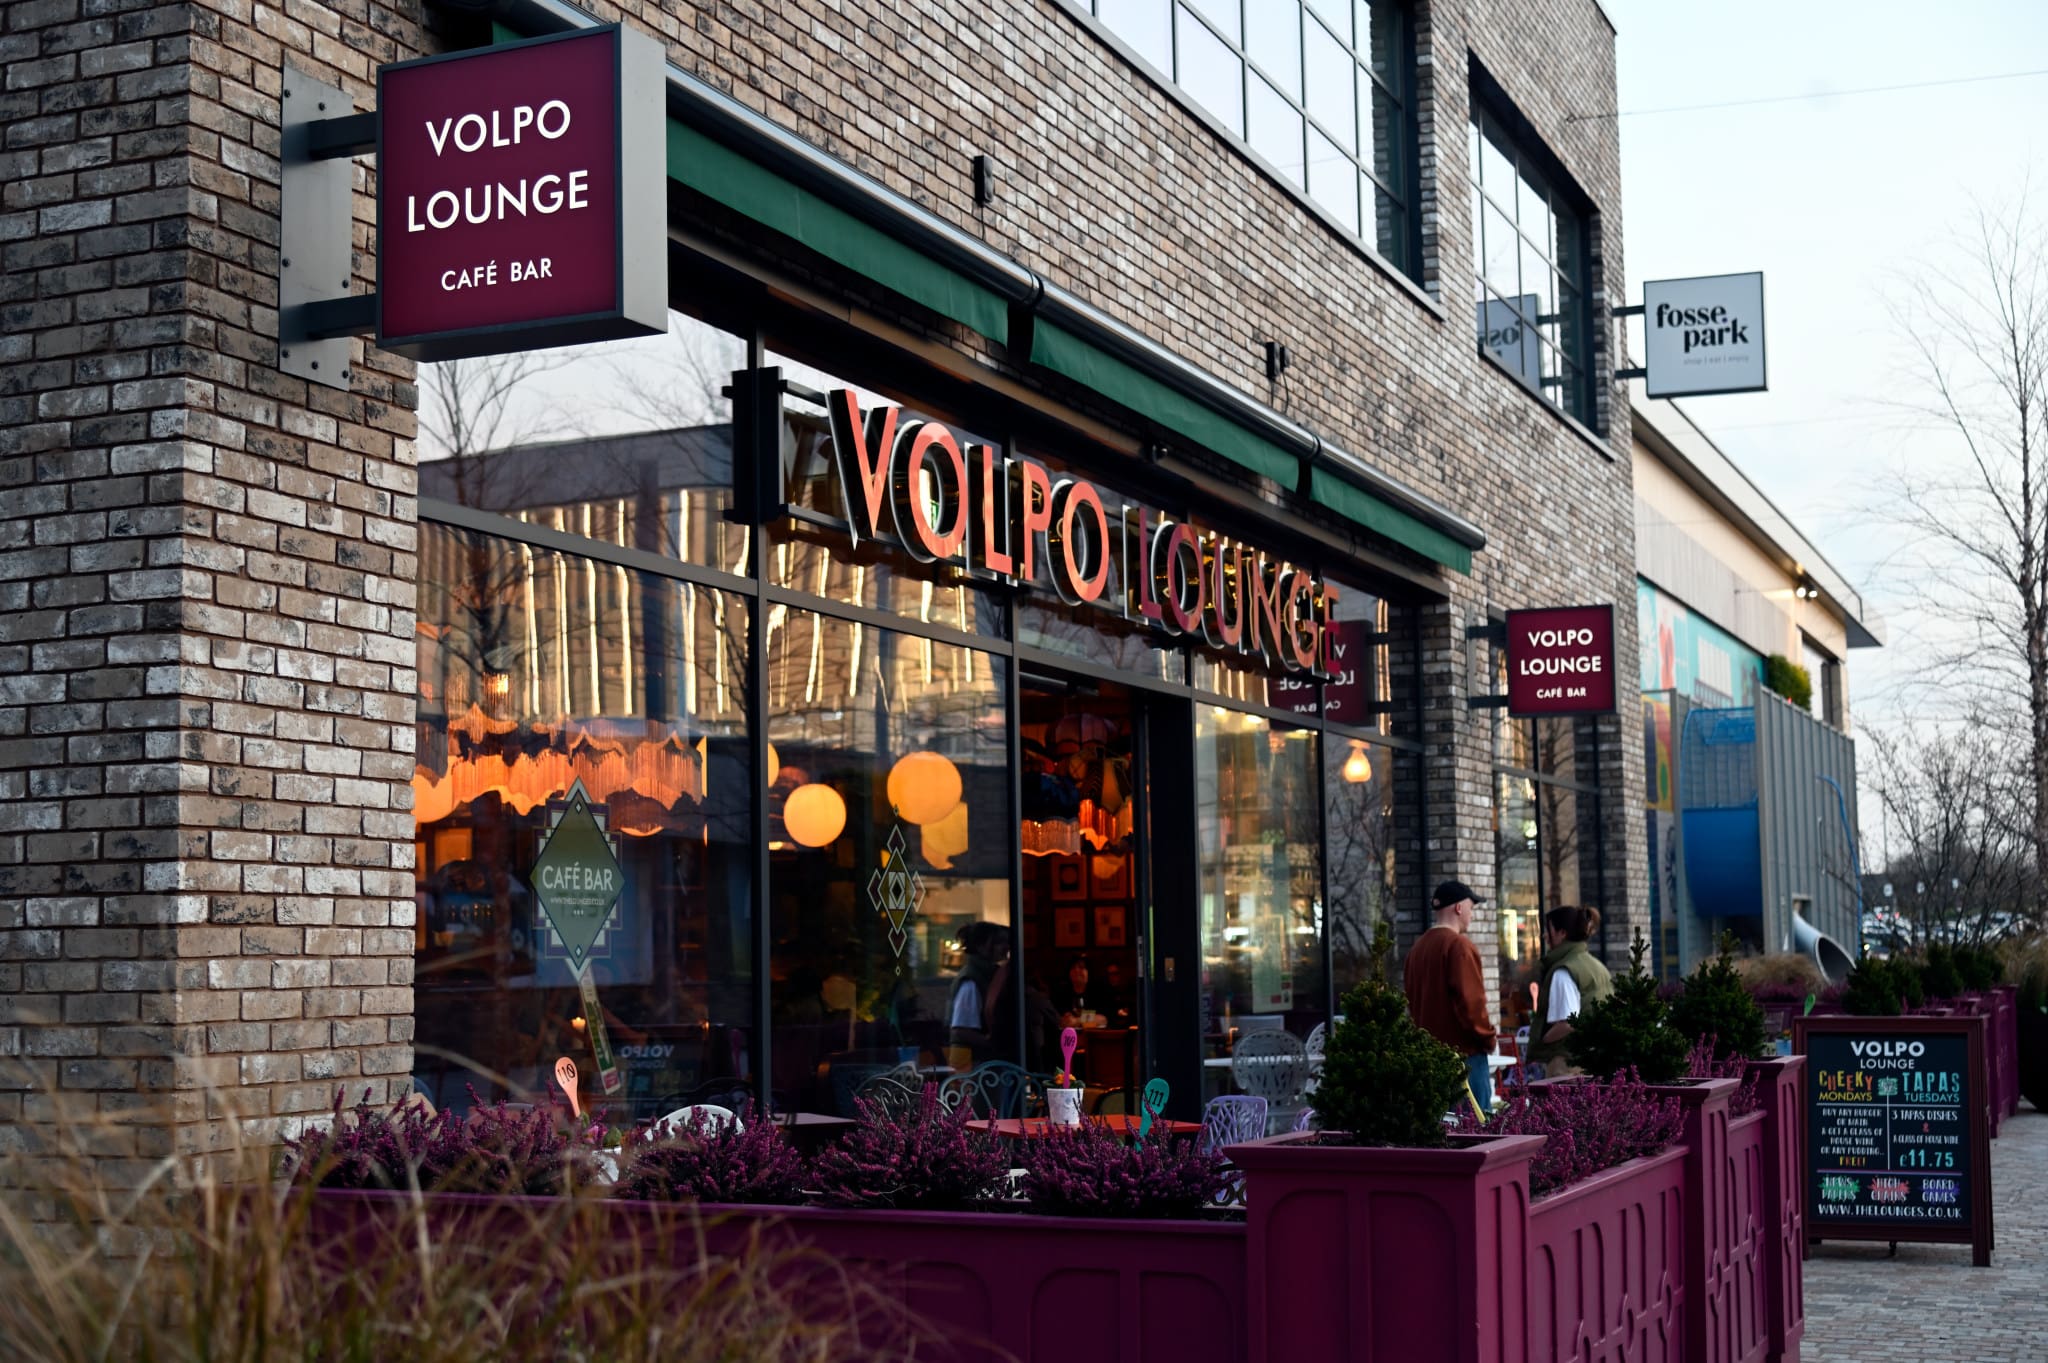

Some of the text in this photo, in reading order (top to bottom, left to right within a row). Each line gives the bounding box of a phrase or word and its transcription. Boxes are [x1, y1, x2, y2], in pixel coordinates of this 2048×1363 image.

[426, 100, 571, 157] VOLPO
[408, 169, 589, 232] LOUNGE
[441, 257, 553, 291] CAFÉ BAR
[1683, 318, 1749, 353] park
[832, 388, 1340, 676] VOLPO LOUNGE
[1528, 628, 1594, 648] VOLPO
[1520, 656, 1602, 676] LOUNGE
[1537, 687, 1587, 699] CAFÉ BAR
[542, 861, 613, 891] CAFÉ BAR
[1851, 1041, 1925, 1057] VOLPO
[1860, 1059, 1915, 1069] LOUNGE
[1819, 1071, 1873, 1092] CHEEKY
[1902, 1072, 1960, 1092] TAPAS
[1819, 1092, 1873, 1101] MONDAYS
[1905, 1093, 1960, 1103] TUESDAYS
[1891, 1110, 1958, 1121] 3 TAPAS DISHES
[1922, 1179, 1955, 1190] BOARD
[1922, 1191, 1956, 1203] GAMES
[1818, 1204, 1962, 1218] WWW.THELOUNGES.CO.UK
